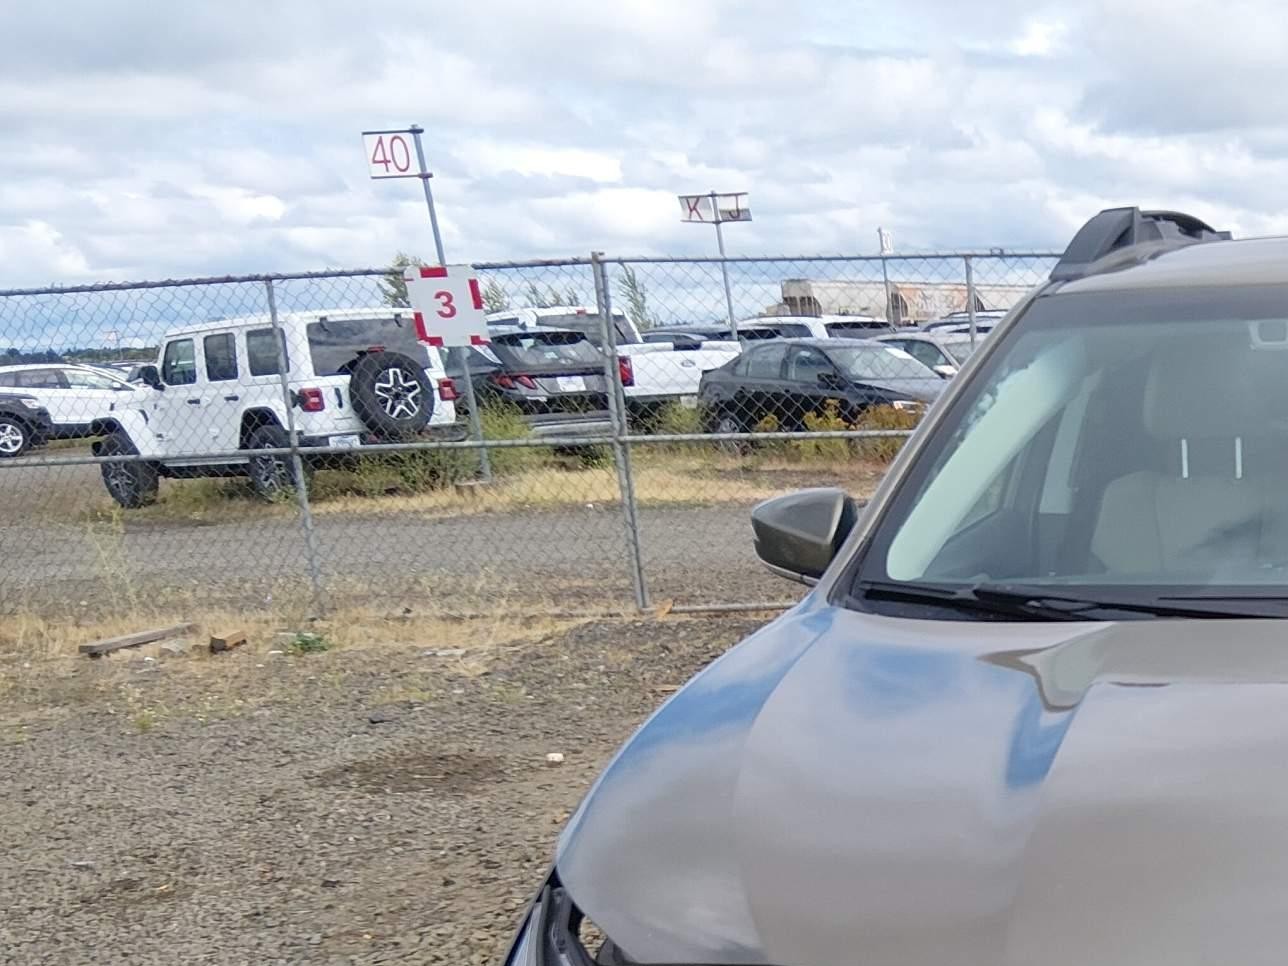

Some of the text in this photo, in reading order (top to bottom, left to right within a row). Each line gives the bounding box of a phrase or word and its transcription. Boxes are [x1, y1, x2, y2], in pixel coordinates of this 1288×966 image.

[371, 134, 410, 173] 40
[685, 196, 704, 220] K
[728, 195, 741, 219] J
[434, 290, 457, 319] 3
